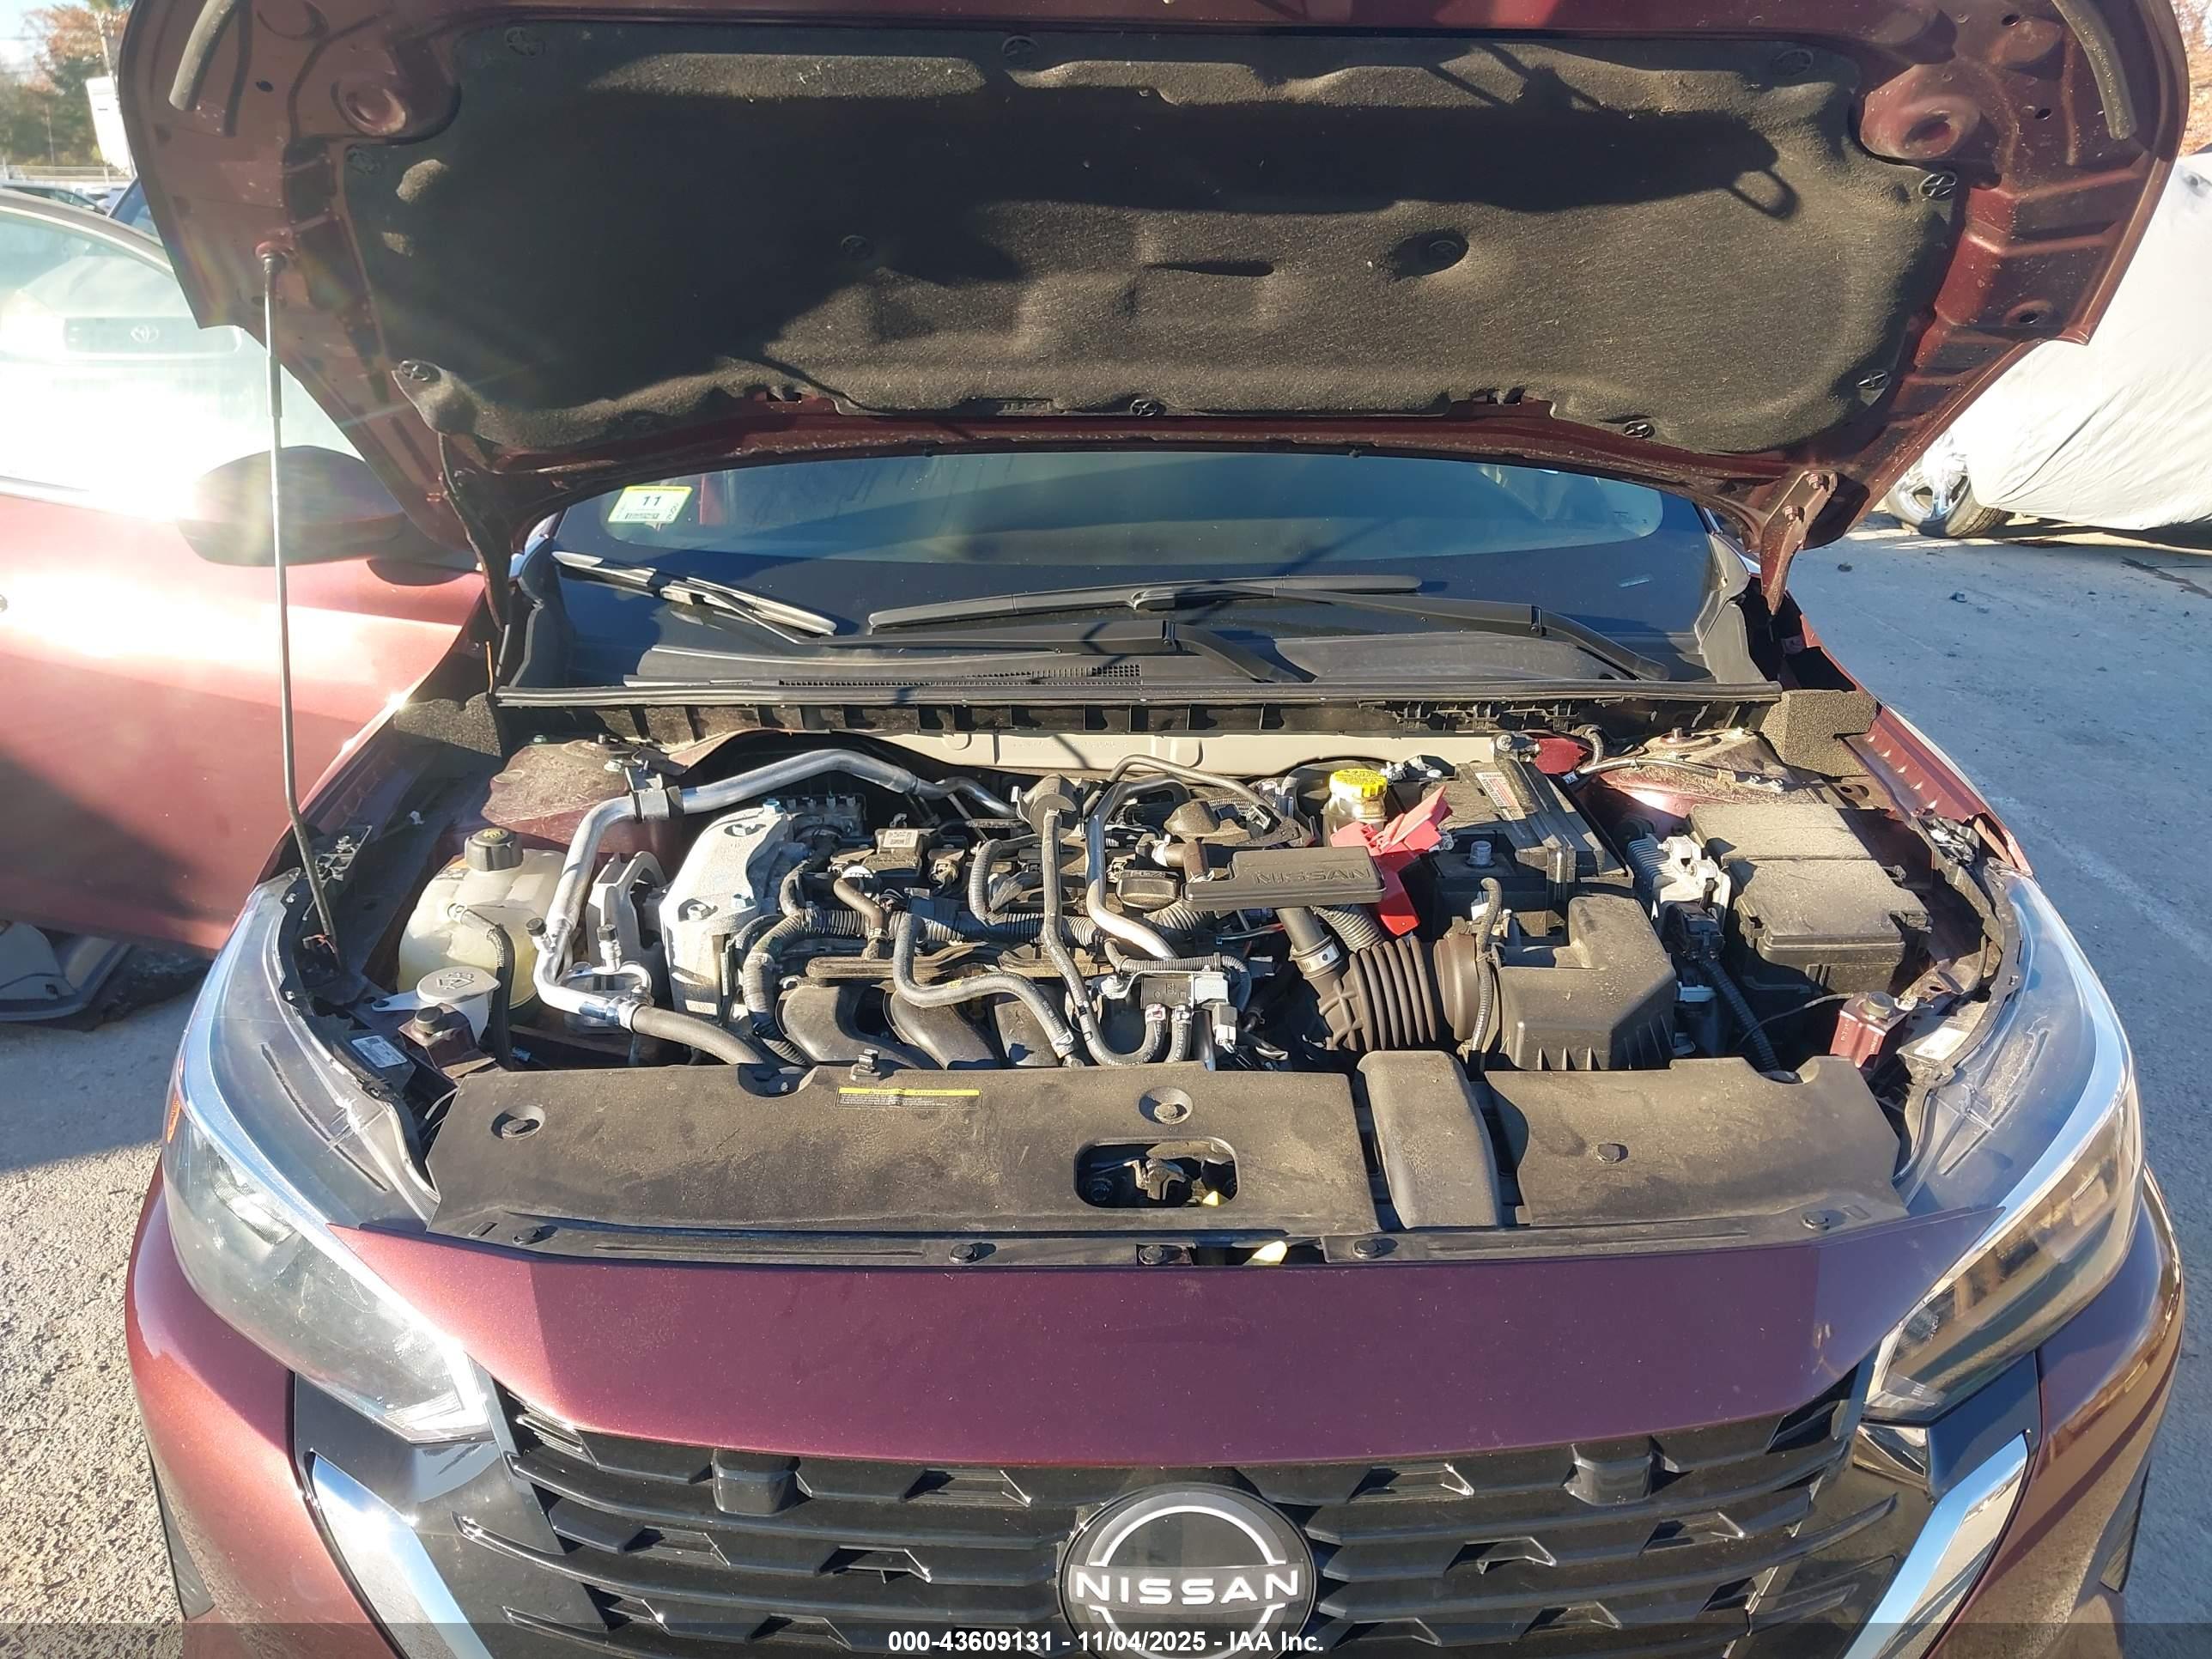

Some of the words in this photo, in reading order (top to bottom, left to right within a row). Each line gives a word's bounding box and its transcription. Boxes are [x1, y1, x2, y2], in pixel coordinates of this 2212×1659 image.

[642, 495, 662, 507] 11
[1251, 867, 1371, 886] NISSAN
[1076, 1570, 1299, 1605] NISSAN
